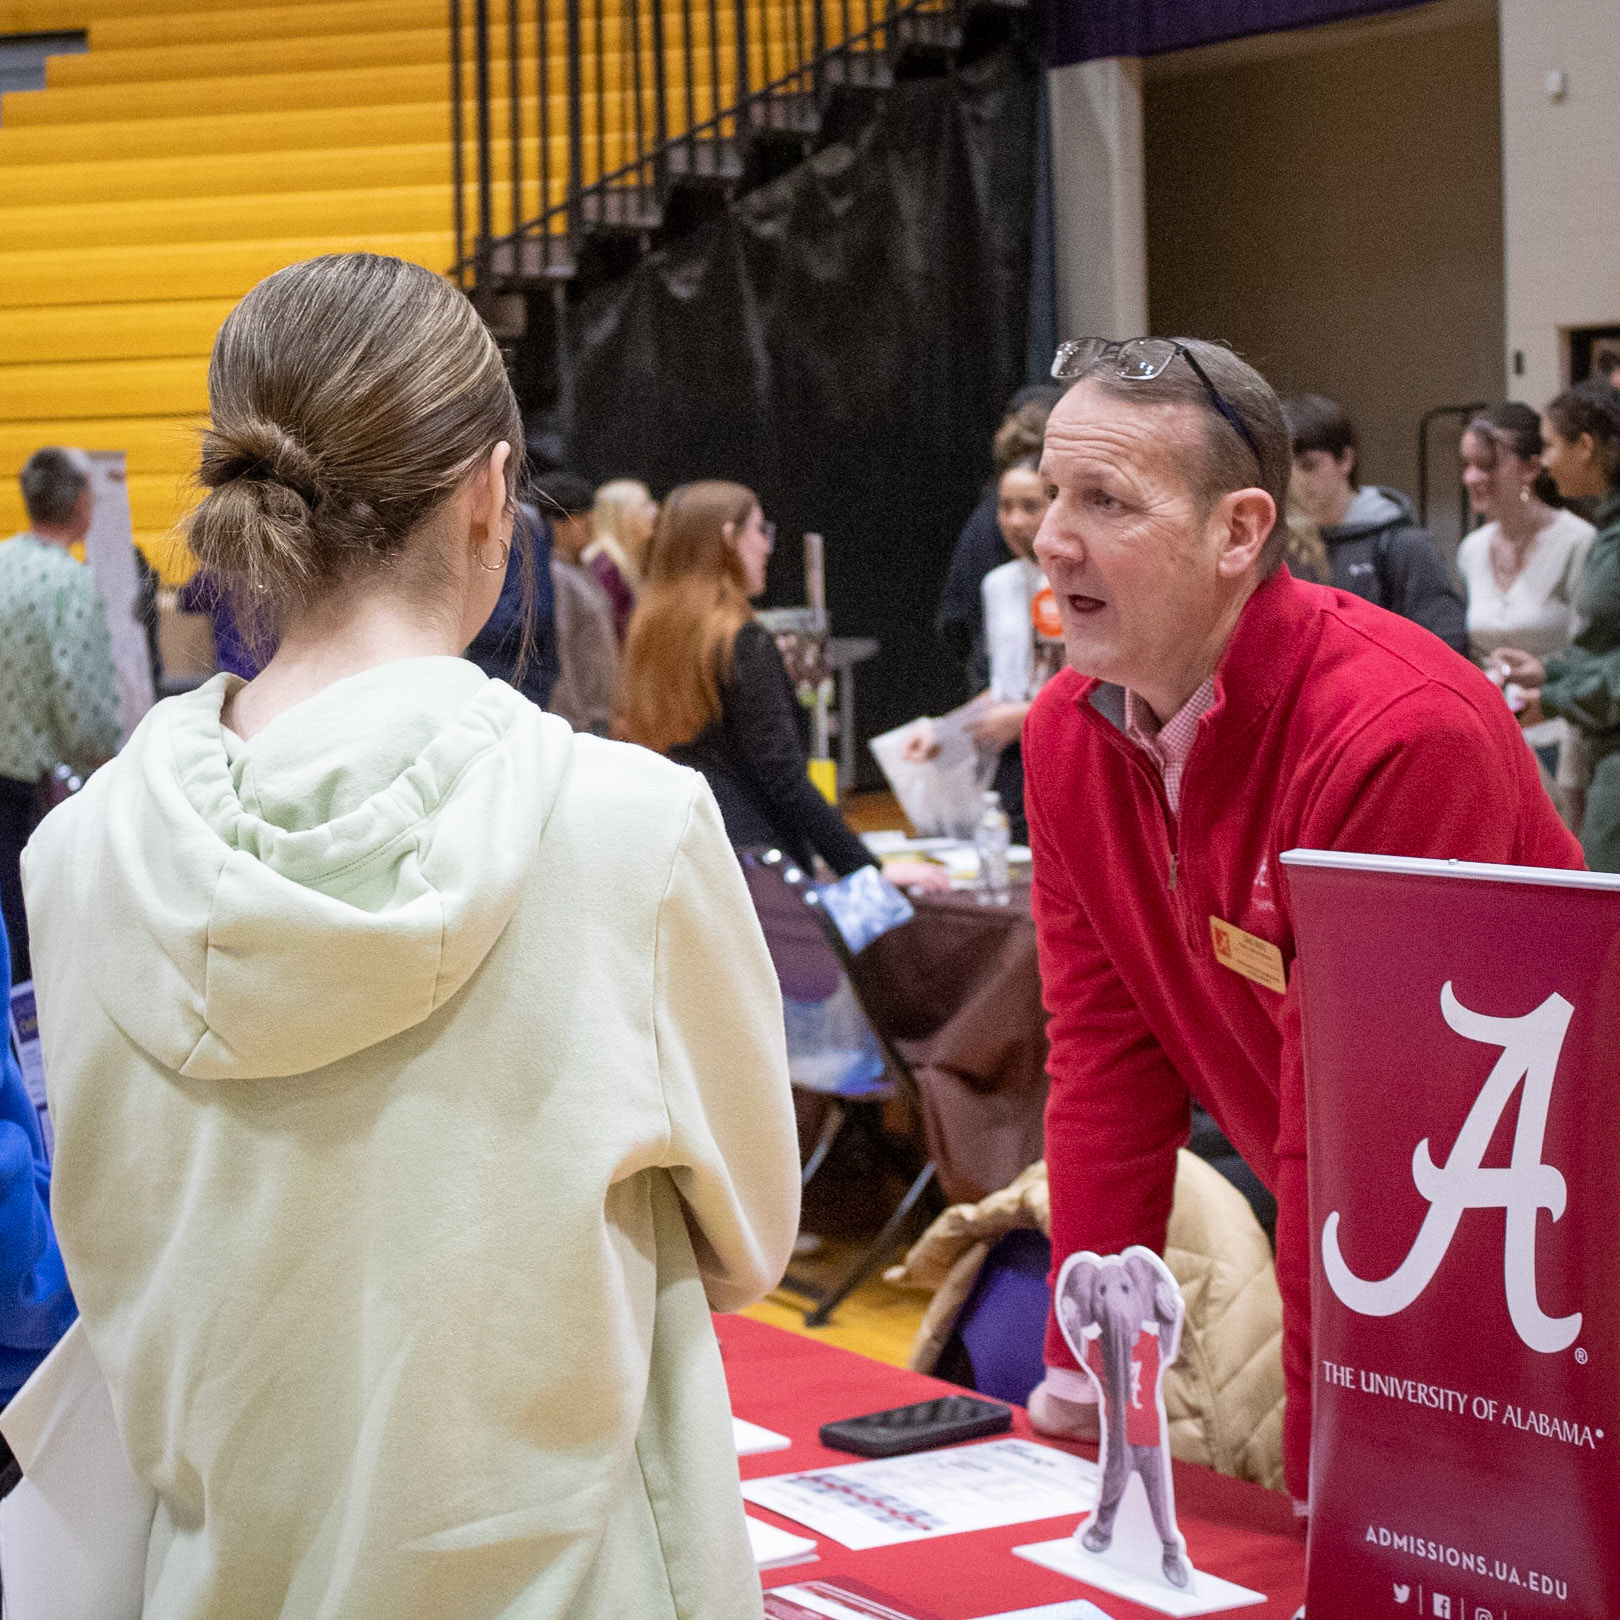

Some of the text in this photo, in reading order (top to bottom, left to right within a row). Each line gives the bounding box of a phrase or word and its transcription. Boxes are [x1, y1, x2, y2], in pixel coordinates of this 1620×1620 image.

[1322, 980, 1582, 1353] A
[1323, 1360, 1356, 1389] THE
[1360, 1369, 1469, 1414] UNIVERSITY
[1472, 1396, 1498, 1422] OF
[1365, 1525, 1568, 1601] ADMISSIONS.UA.EDU
